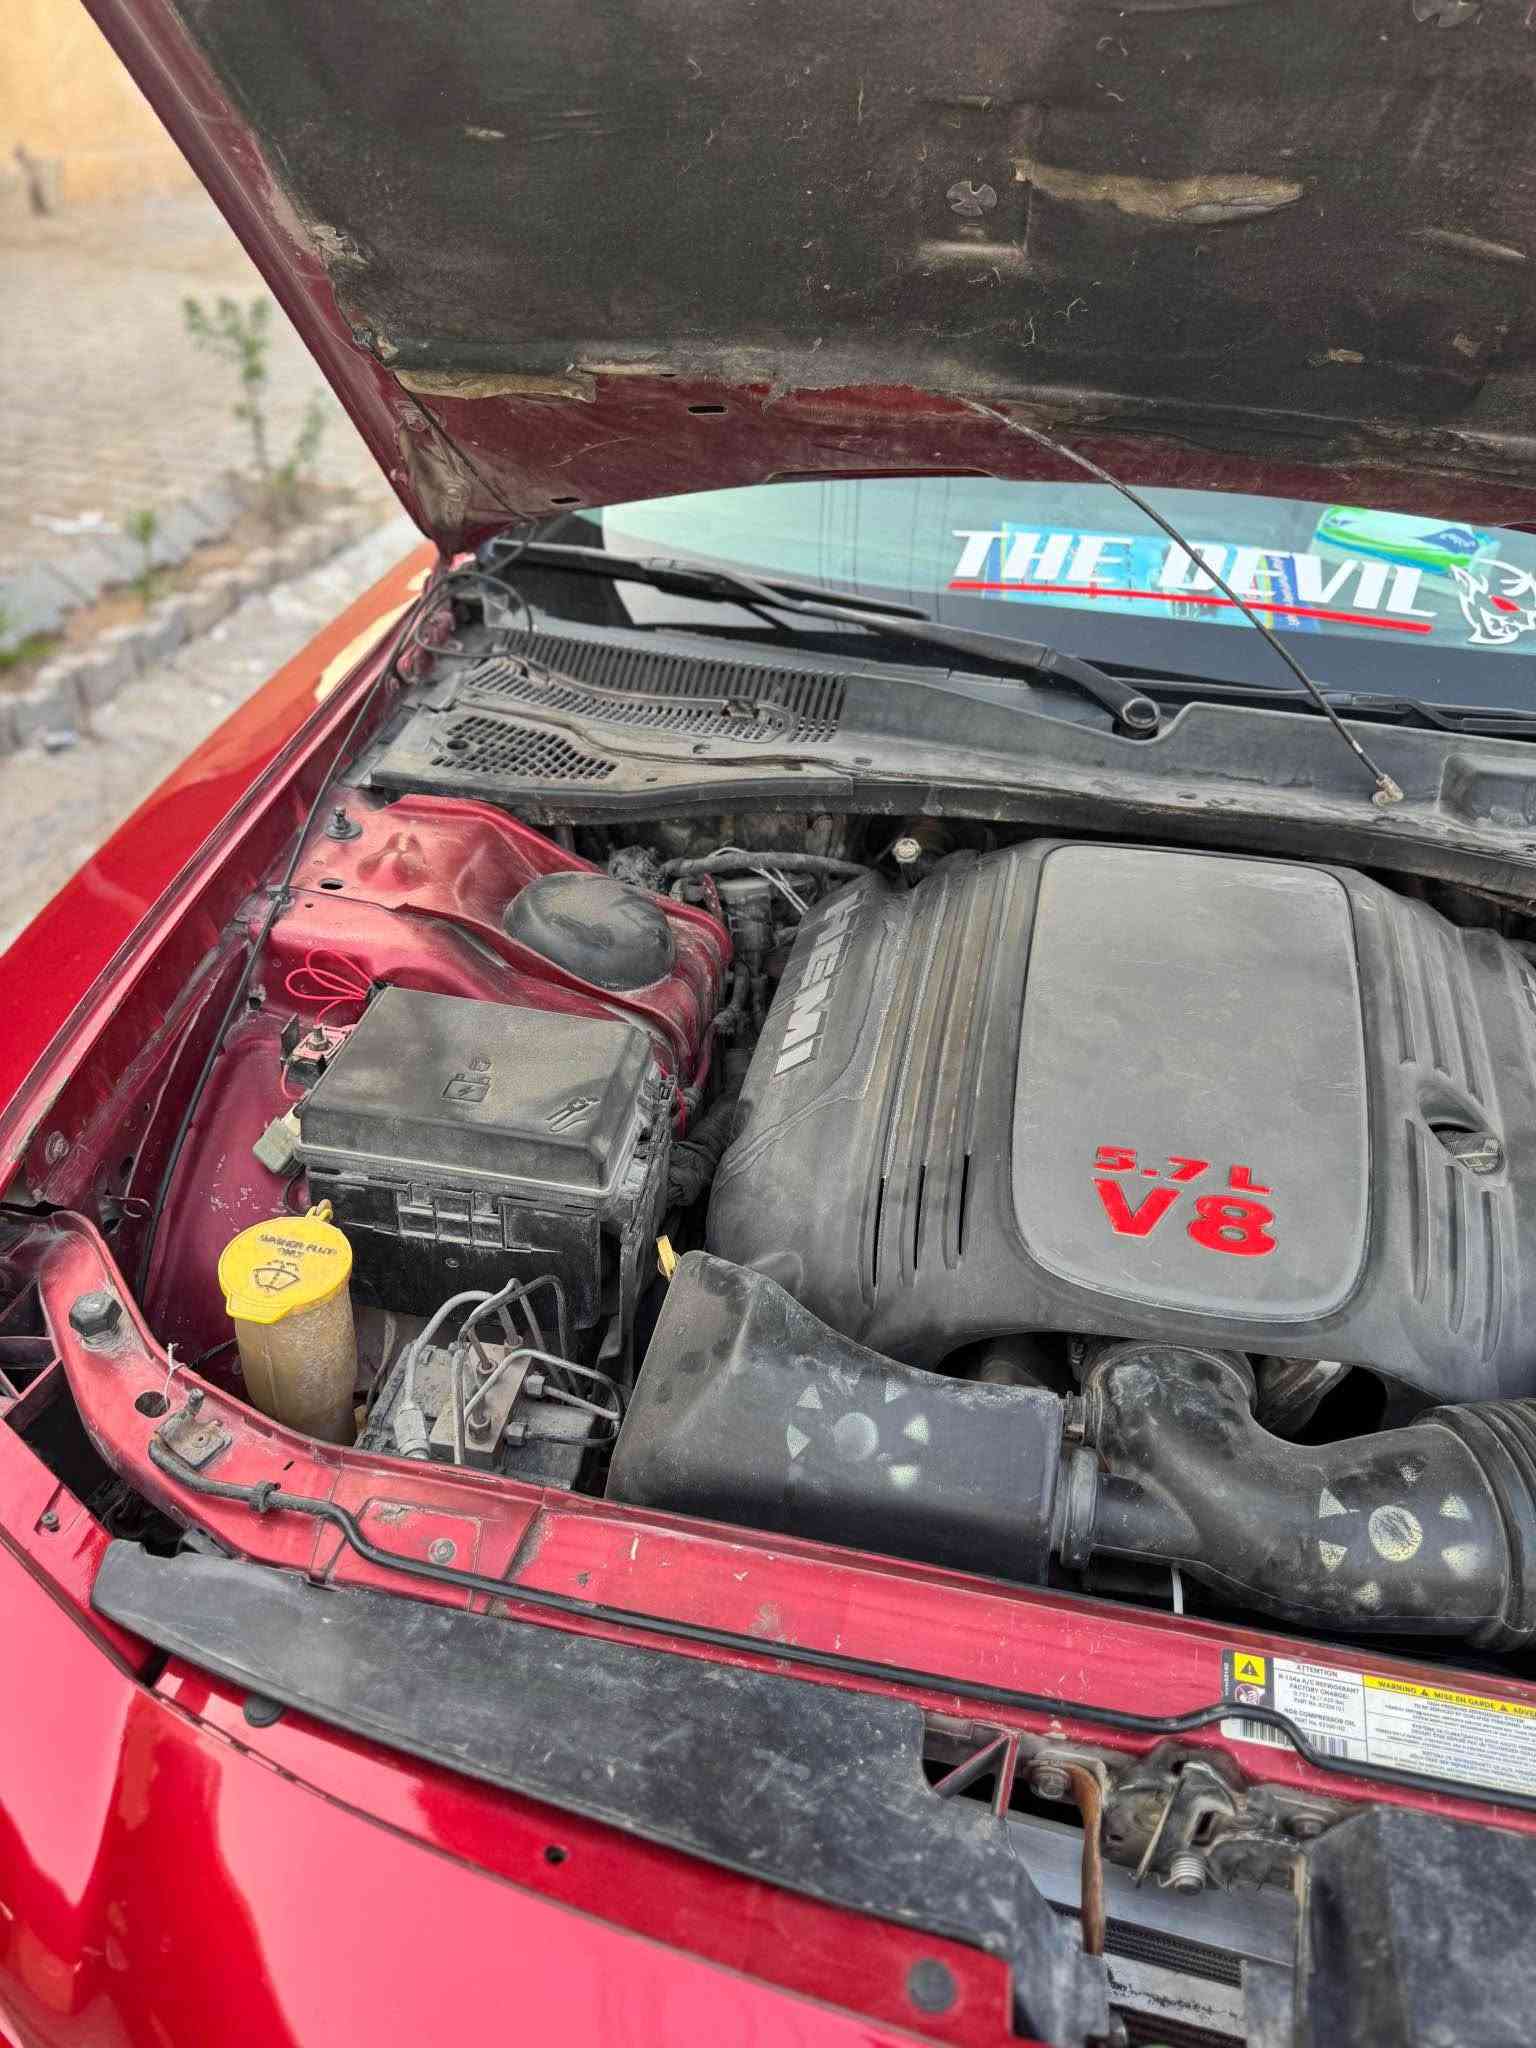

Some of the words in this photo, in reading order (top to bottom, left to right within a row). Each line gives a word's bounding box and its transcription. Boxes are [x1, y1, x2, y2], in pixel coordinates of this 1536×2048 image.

[952, 529, 1134, 583] THE
[1157, 541, 1437, 618] DEVIL
[775, 889, 867, 1077] HEMI
[1092, 1145, 1273, 1196] 5.7L
[1092, 1177, 1278, 1258] V8
[1289, 1683, 1319, 1693] FACTORY
[1296, 1664, 1338, 1678] ATTENTION
[1378, 1680, 1416, 1694] WARNING
